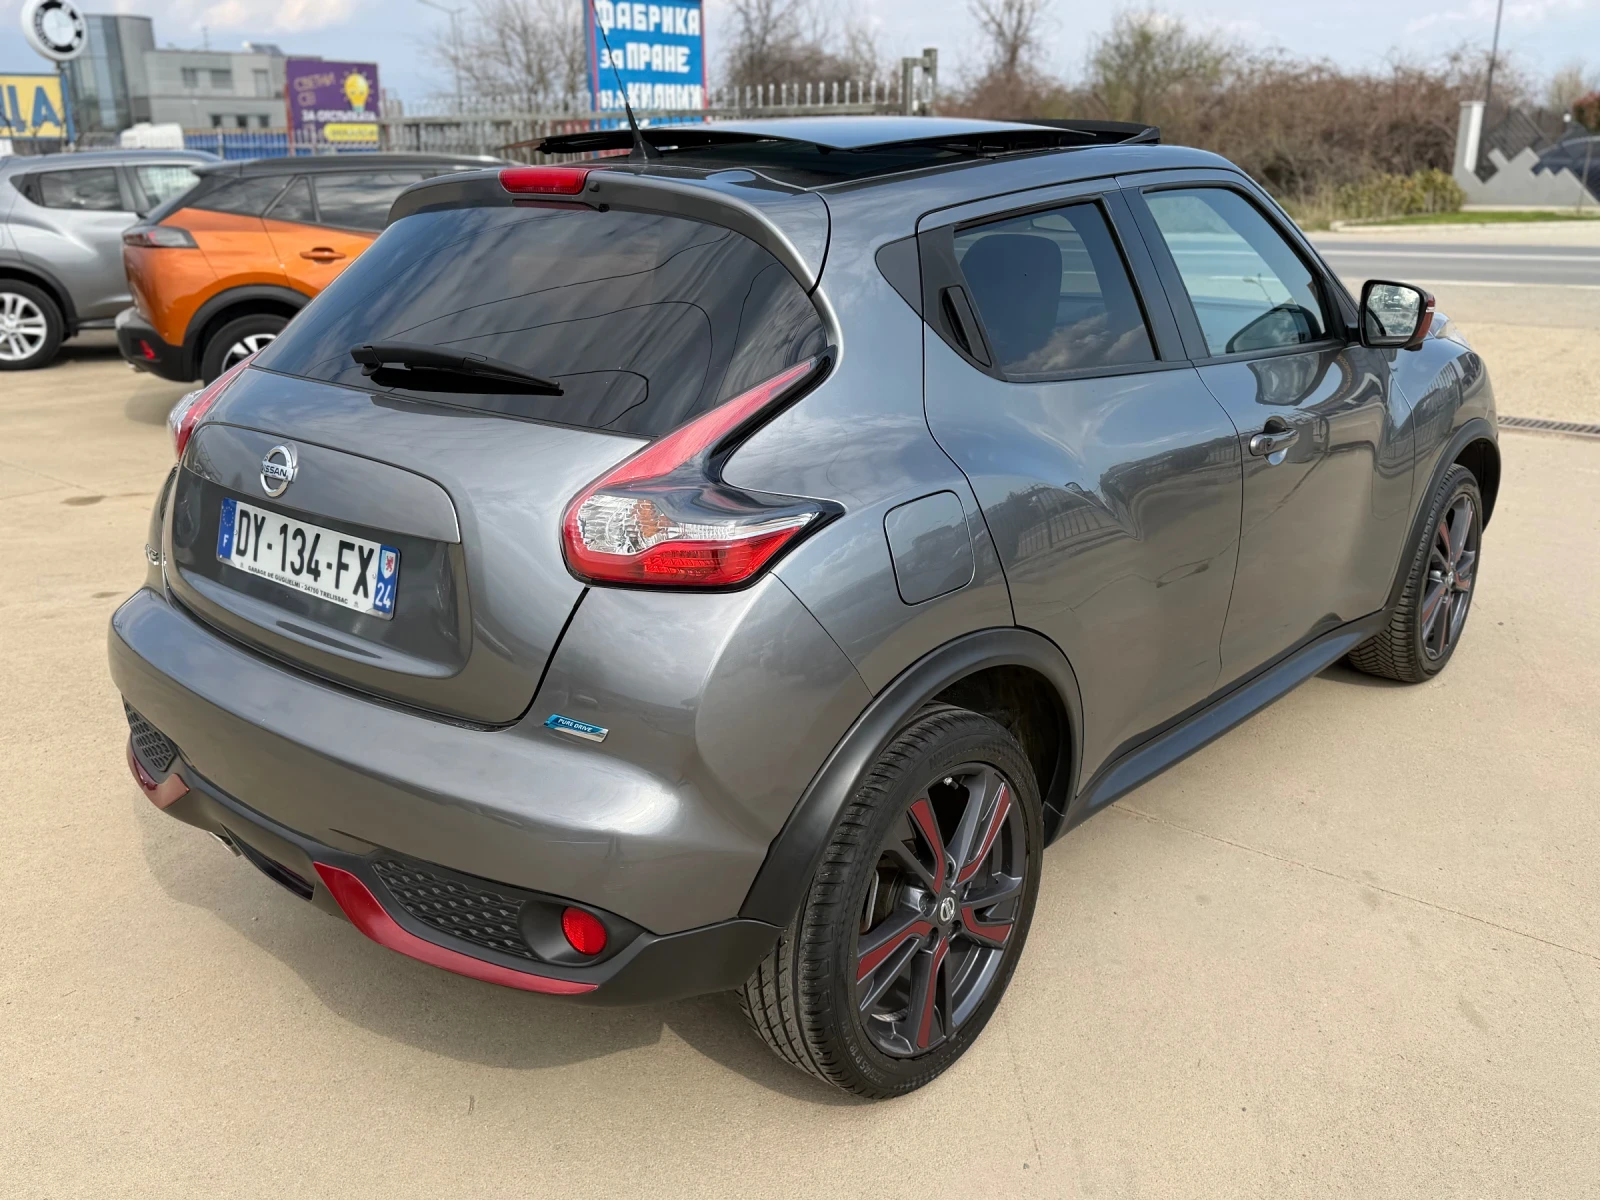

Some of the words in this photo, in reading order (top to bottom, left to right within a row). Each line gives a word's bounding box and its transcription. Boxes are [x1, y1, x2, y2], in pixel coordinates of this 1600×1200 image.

[594, 0, 701, 36] ФАБРИКА
[626, 41, 690, 74] ПРАНЕ
[222, 534, 229, 548] F
[235, 508, 375, 600] DY-134-FX
[247, 565, 267, 577] GARAGE
[319, 590, 349, 605] TRELISSAC
[374, 582, 392, 609] 24
[557, 718, 574, 727] PURE
[573, 724, 593, 733] DRIVE
